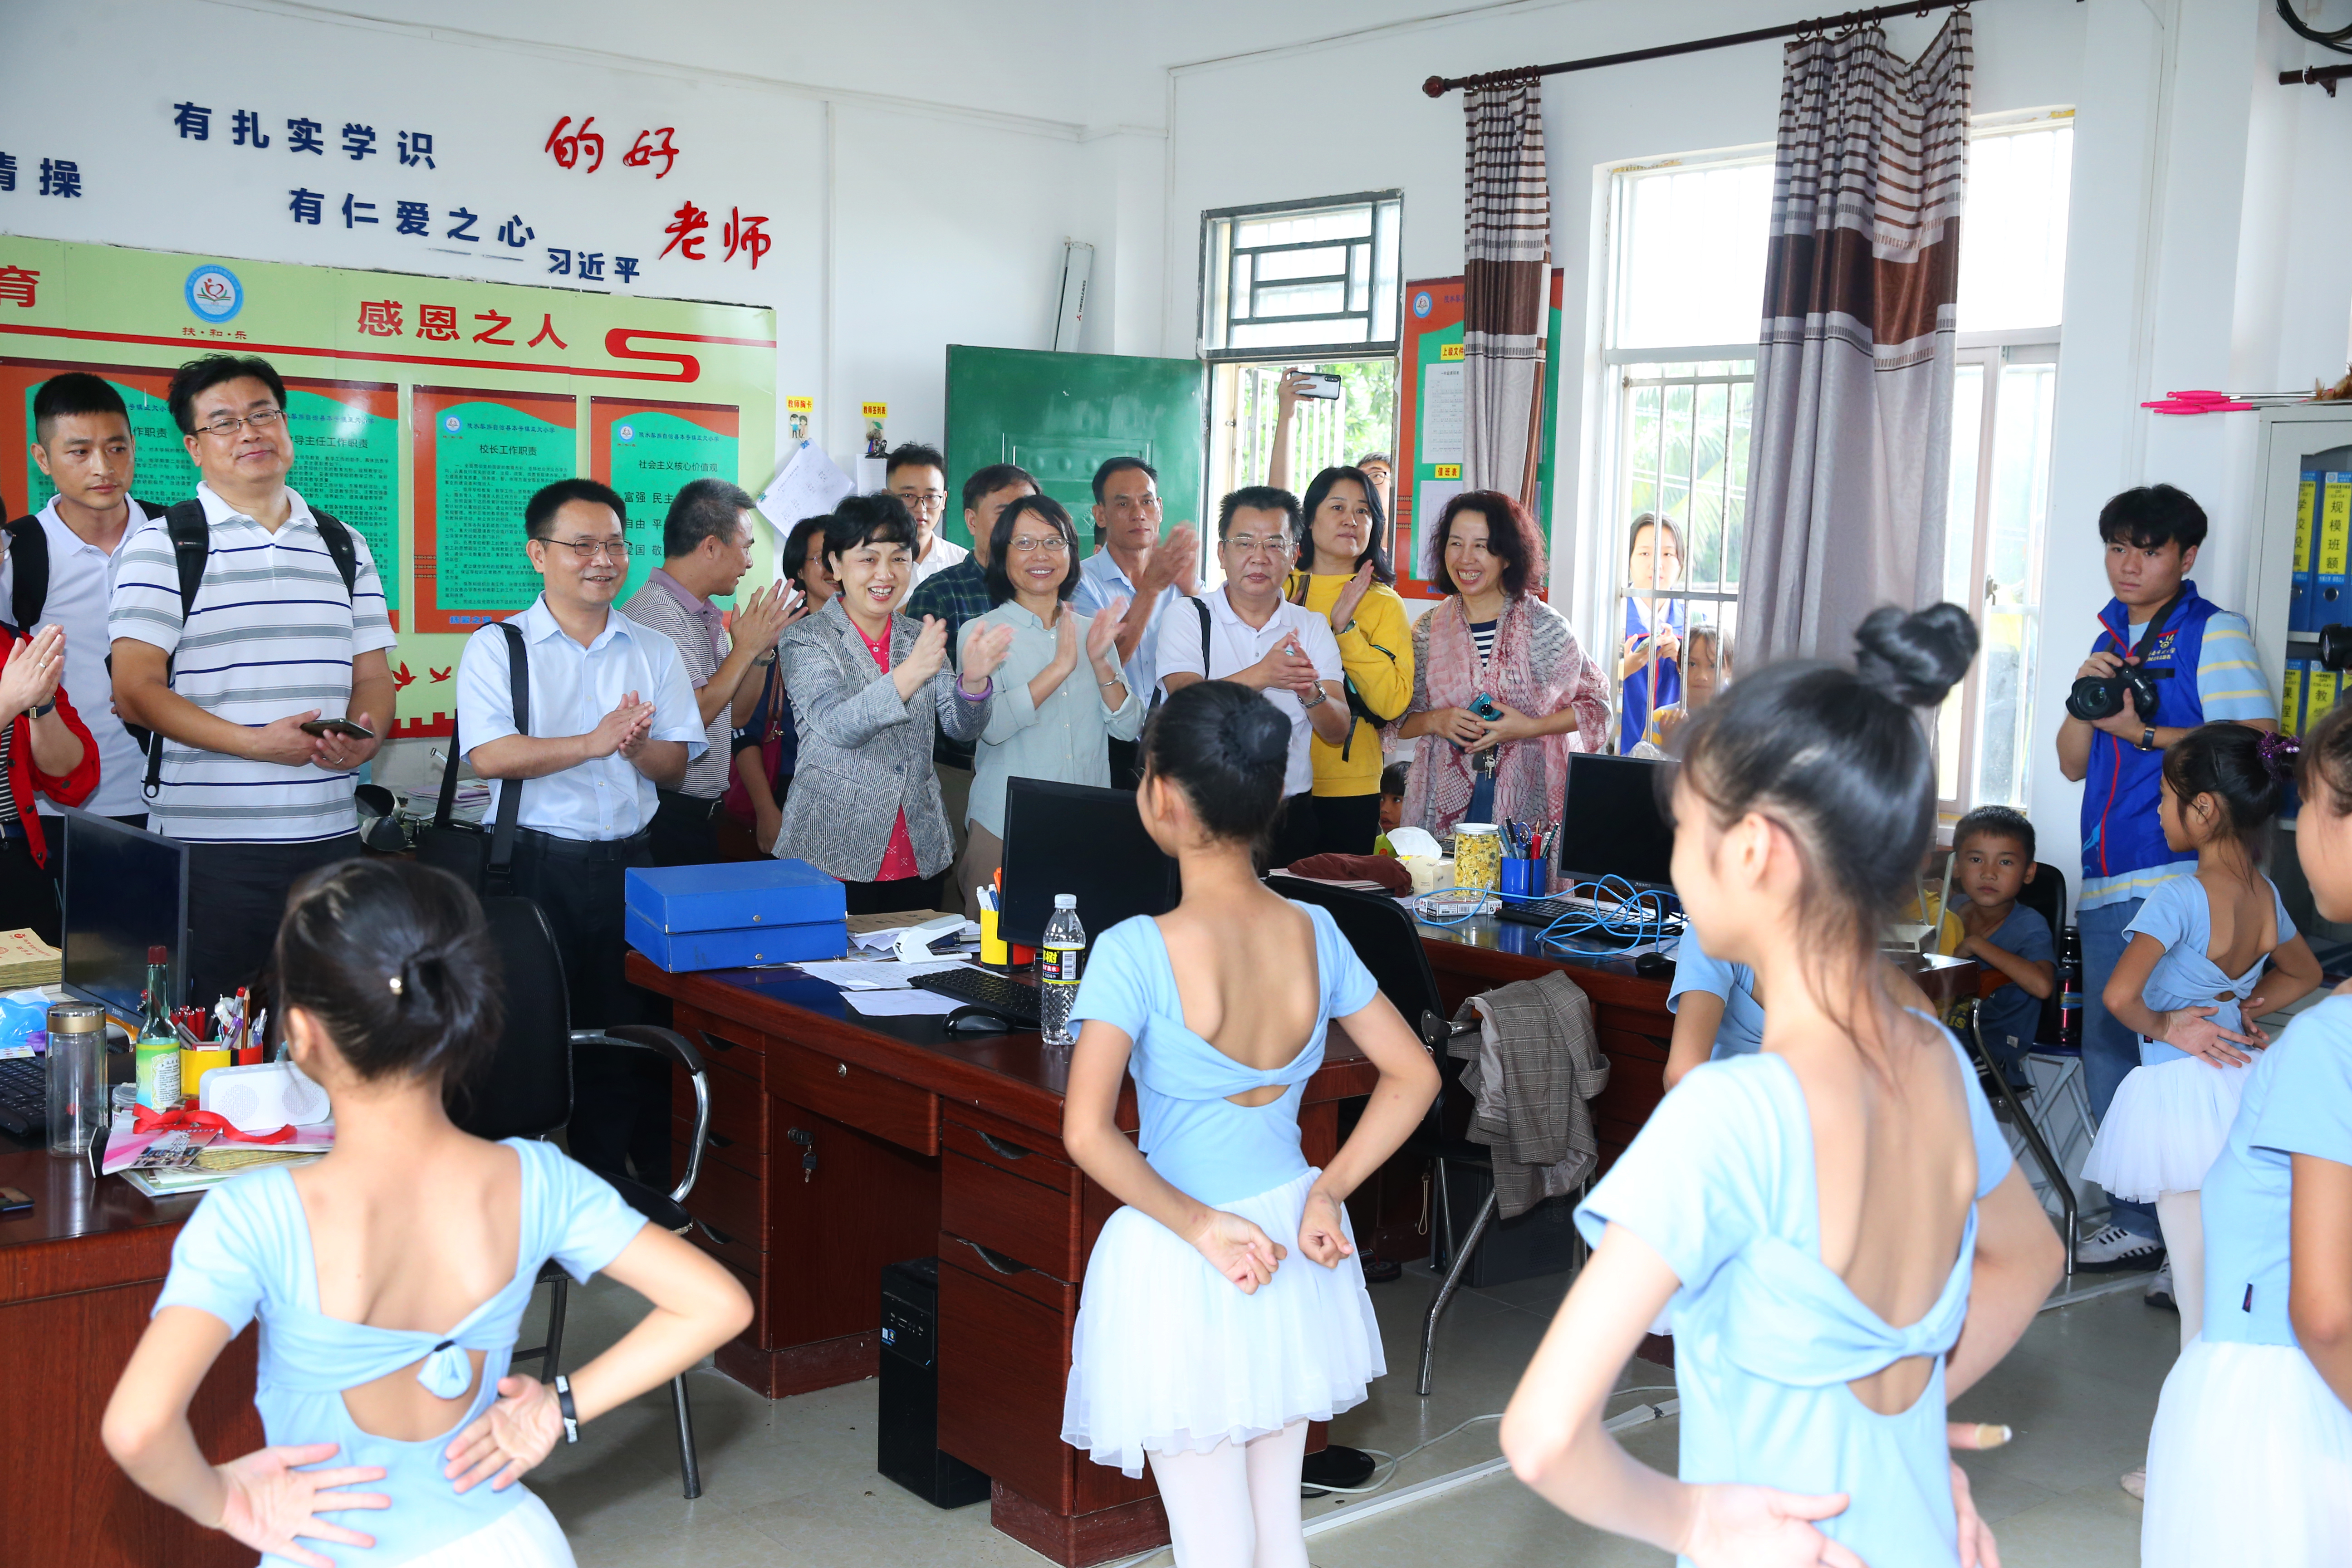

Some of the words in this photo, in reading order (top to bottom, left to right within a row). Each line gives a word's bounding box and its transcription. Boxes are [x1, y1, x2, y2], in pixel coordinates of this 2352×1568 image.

[174, 101, 436, 170] 有扎实学识
[545, 116, 679, 179] 的好
[289, 187, 535, 248] 有仁爱之心
[659, 201, 772, 270] 老师
[0, 265, 40, 308] 育
[548, 248, 640, 284] 习近平
[358, 299, 568, 350] 感恩之人
[788, 399, 812, 409] 教师胸卡
[864, 406, 886, 415] 教师签到表
[480, 444, 537, 456] 校长工作职责
[639, 460, 718, 472] 社会主义核心价值观
[624, 491, 645, 503] 富强
[653, 493, 673, 504] 民主
[2326, 500, 2343, 569] 规模班额
